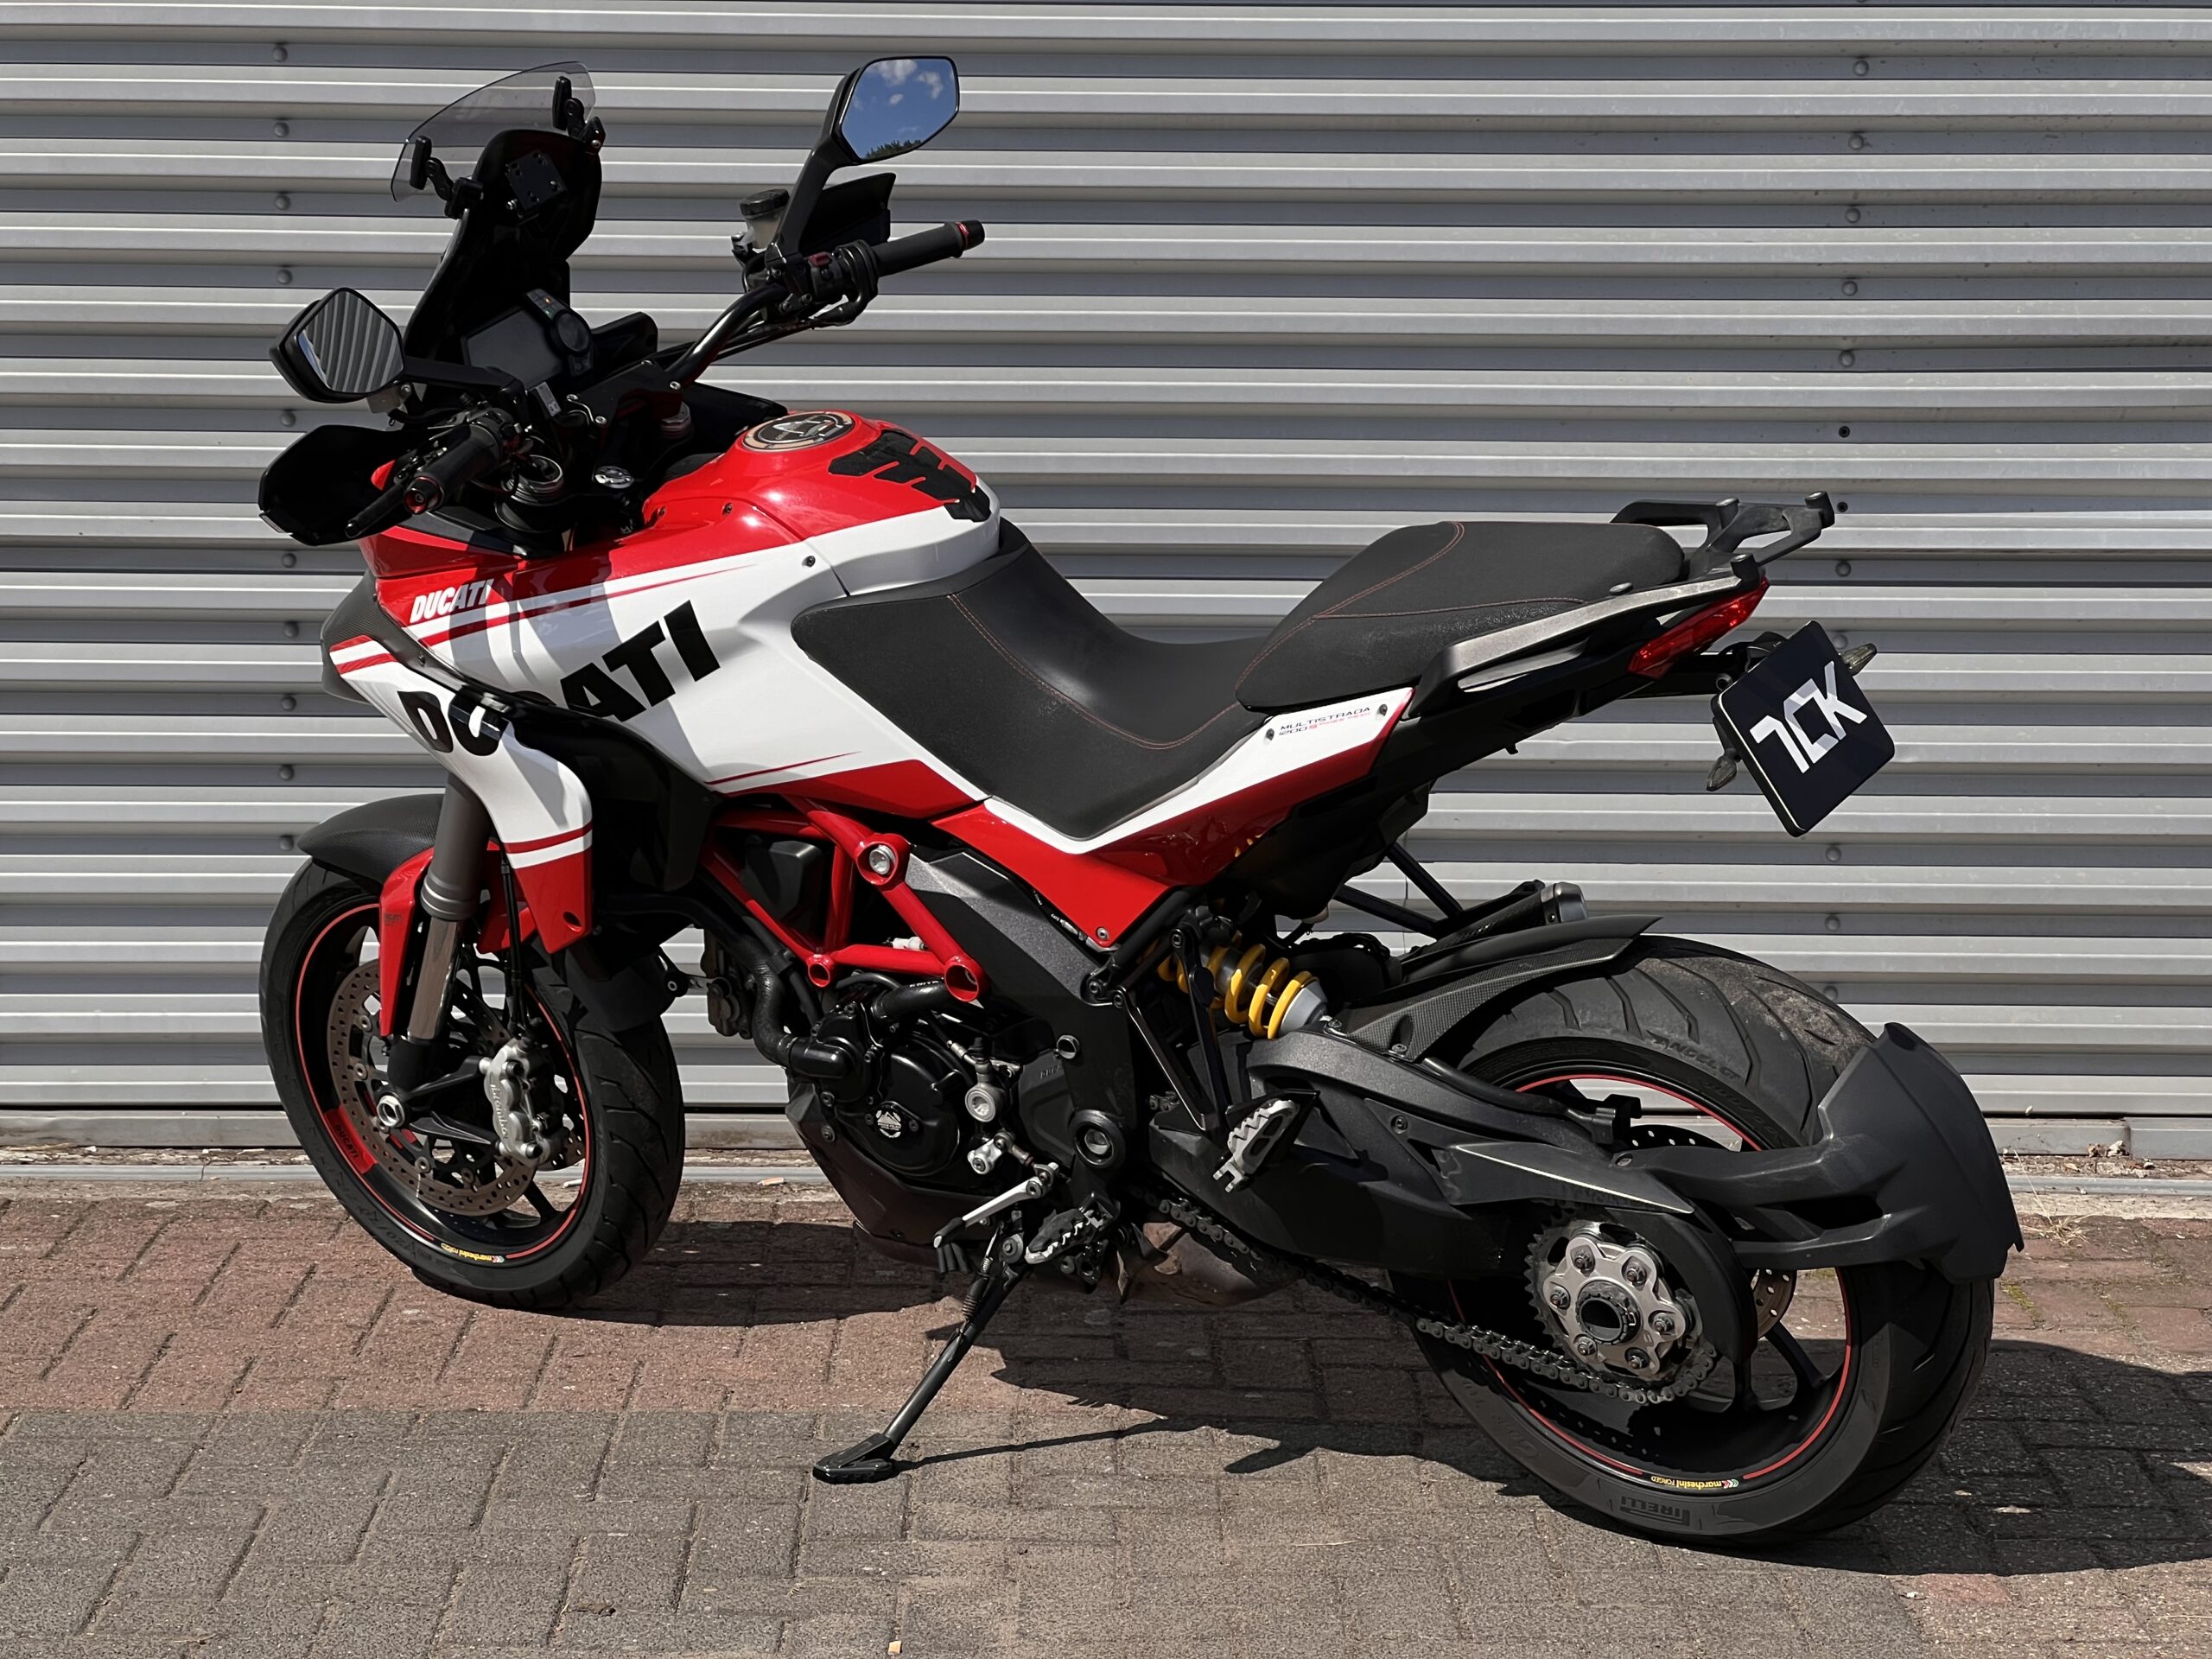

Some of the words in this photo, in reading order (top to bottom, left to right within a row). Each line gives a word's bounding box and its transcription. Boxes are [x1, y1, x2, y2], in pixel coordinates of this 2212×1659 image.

[410, 580, 493, 622] DUCATI
[397, 600, 721, 756] DUATI
[1281, 707, 1370, 730] MULTISTRADA
[334, 1124, 359, 1159] DUCATI
[1675, 1478, 1722, 1490] marchesini
[1620, 1496, 1690, 1526] PIRELLI
